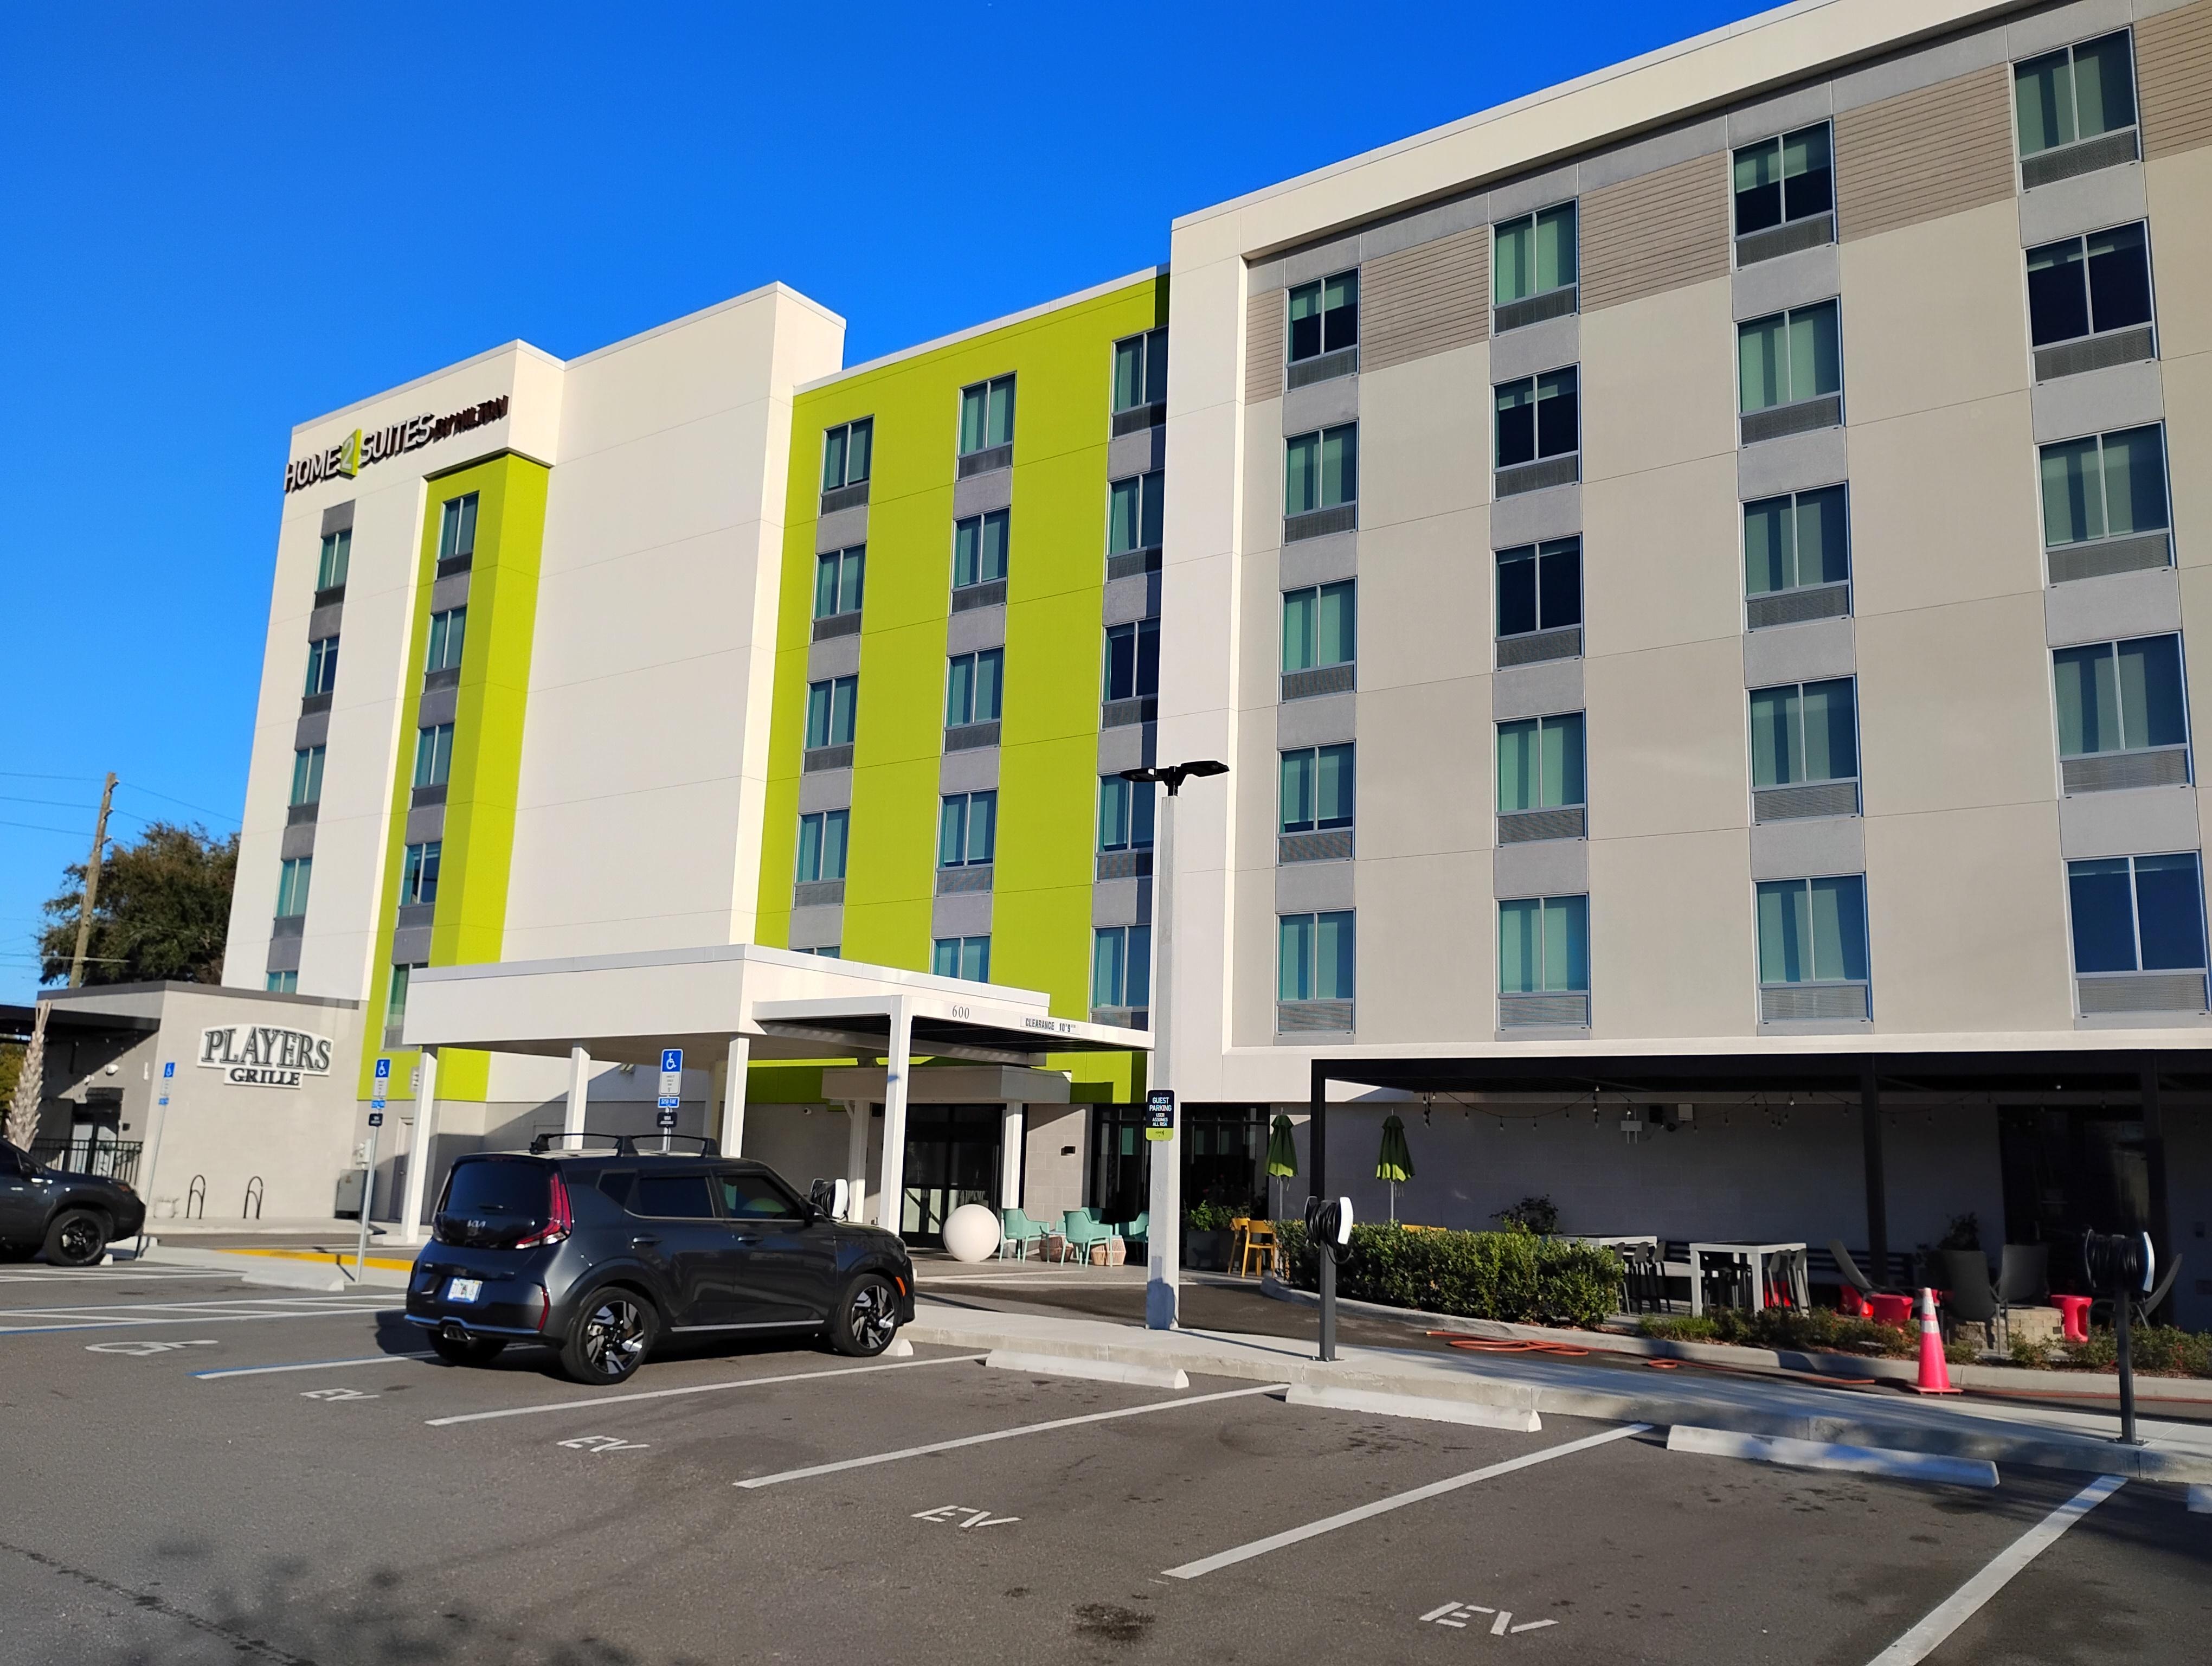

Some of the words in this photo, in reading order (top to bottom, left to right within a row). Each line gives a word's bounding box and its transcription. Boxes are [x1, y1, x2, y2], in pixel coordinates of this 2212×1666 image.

[358, 412, 434, 467] SUITES
[952, 1005, 970, 1020] 600
[1025, 1017, 1055, 1031] CLEARANCE
[201, 1026, 332, 1072] PLAYERS
[230, 1068, 300, 1086] GRILLE
[299, 1388, 381, 1402] EV
[556, 1435, 650, 1453] EV
[910, 1505, 1023, 1528] EV
[1418, 1601, 1560, 1636] EV
